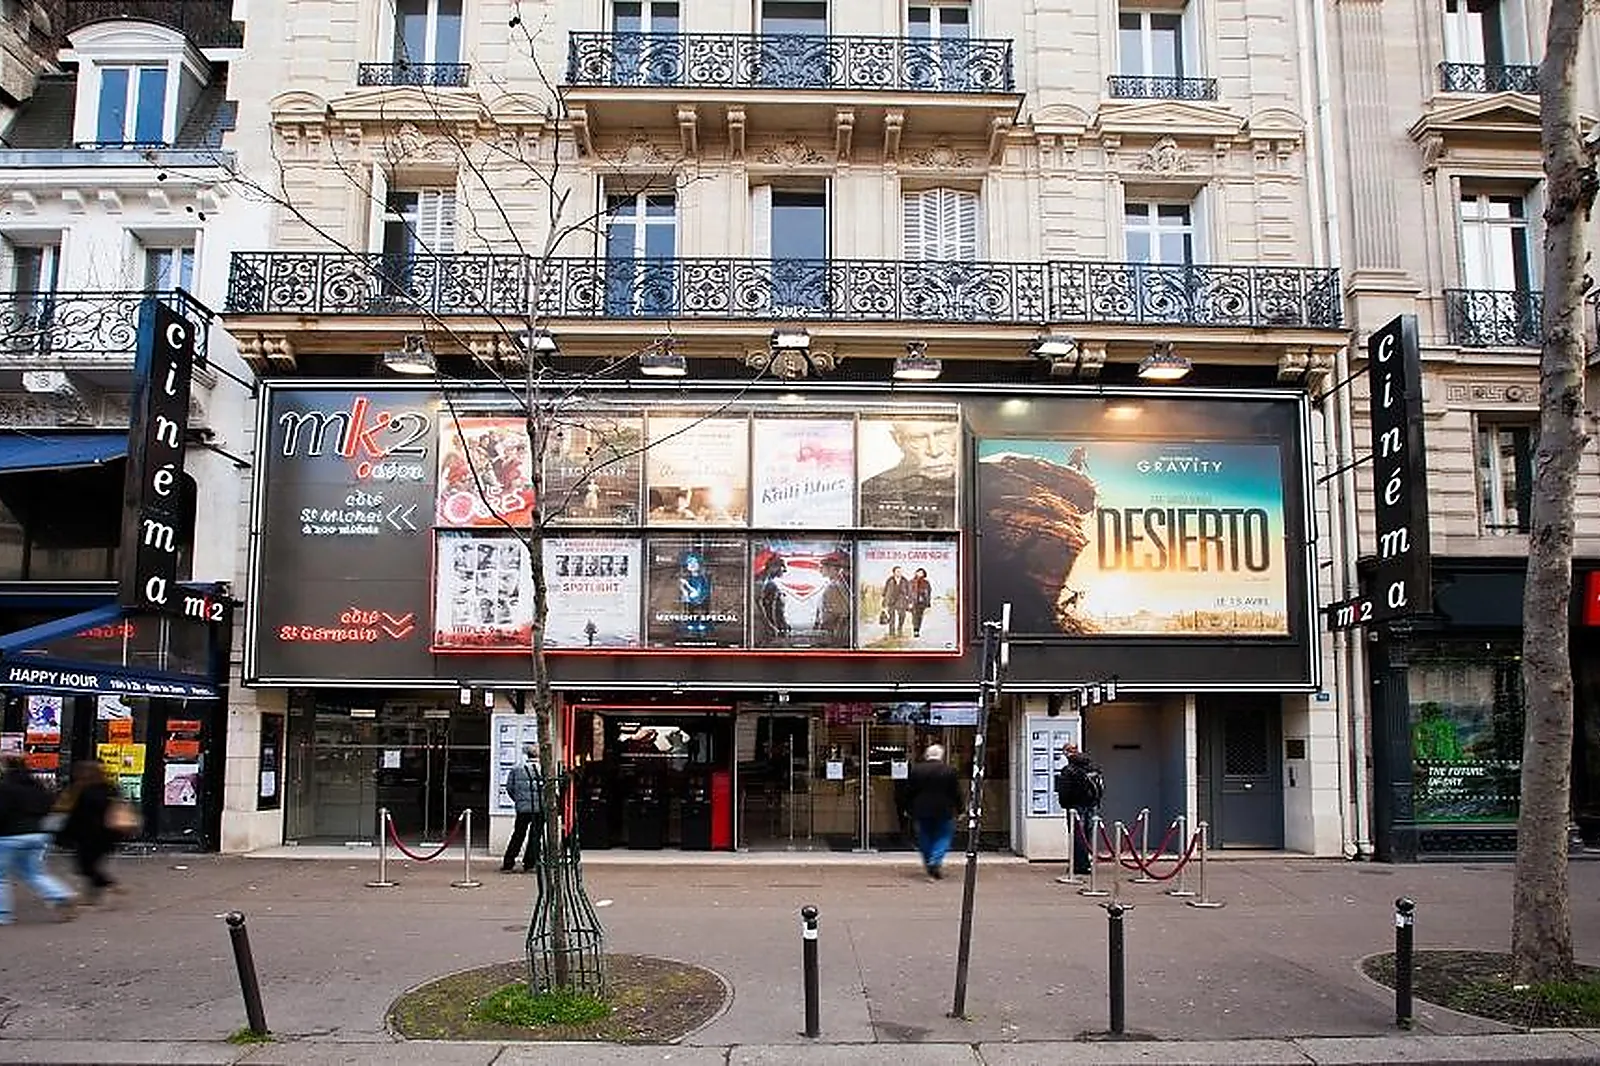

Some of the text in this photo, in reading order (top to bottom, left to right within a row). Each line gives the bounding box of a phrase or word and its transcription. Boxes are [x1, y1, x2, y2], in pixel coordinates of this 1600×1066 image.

[279, 396, 431, 458] mk2
[144, 322, 186, 605] cinéma
[1136, 460, 1222, 473] GRAVITY
[1378, 334, 1410, 609] cinéma
[1097, 507, 1271, 572] DESIERTO
[563, 583, 620, 592] SPOTLIGHT
[184, 595, 224, 622] mk2
[300, 626, 378, 642] Germain
[9, 668, 99, 688] HAPPY HOUR
